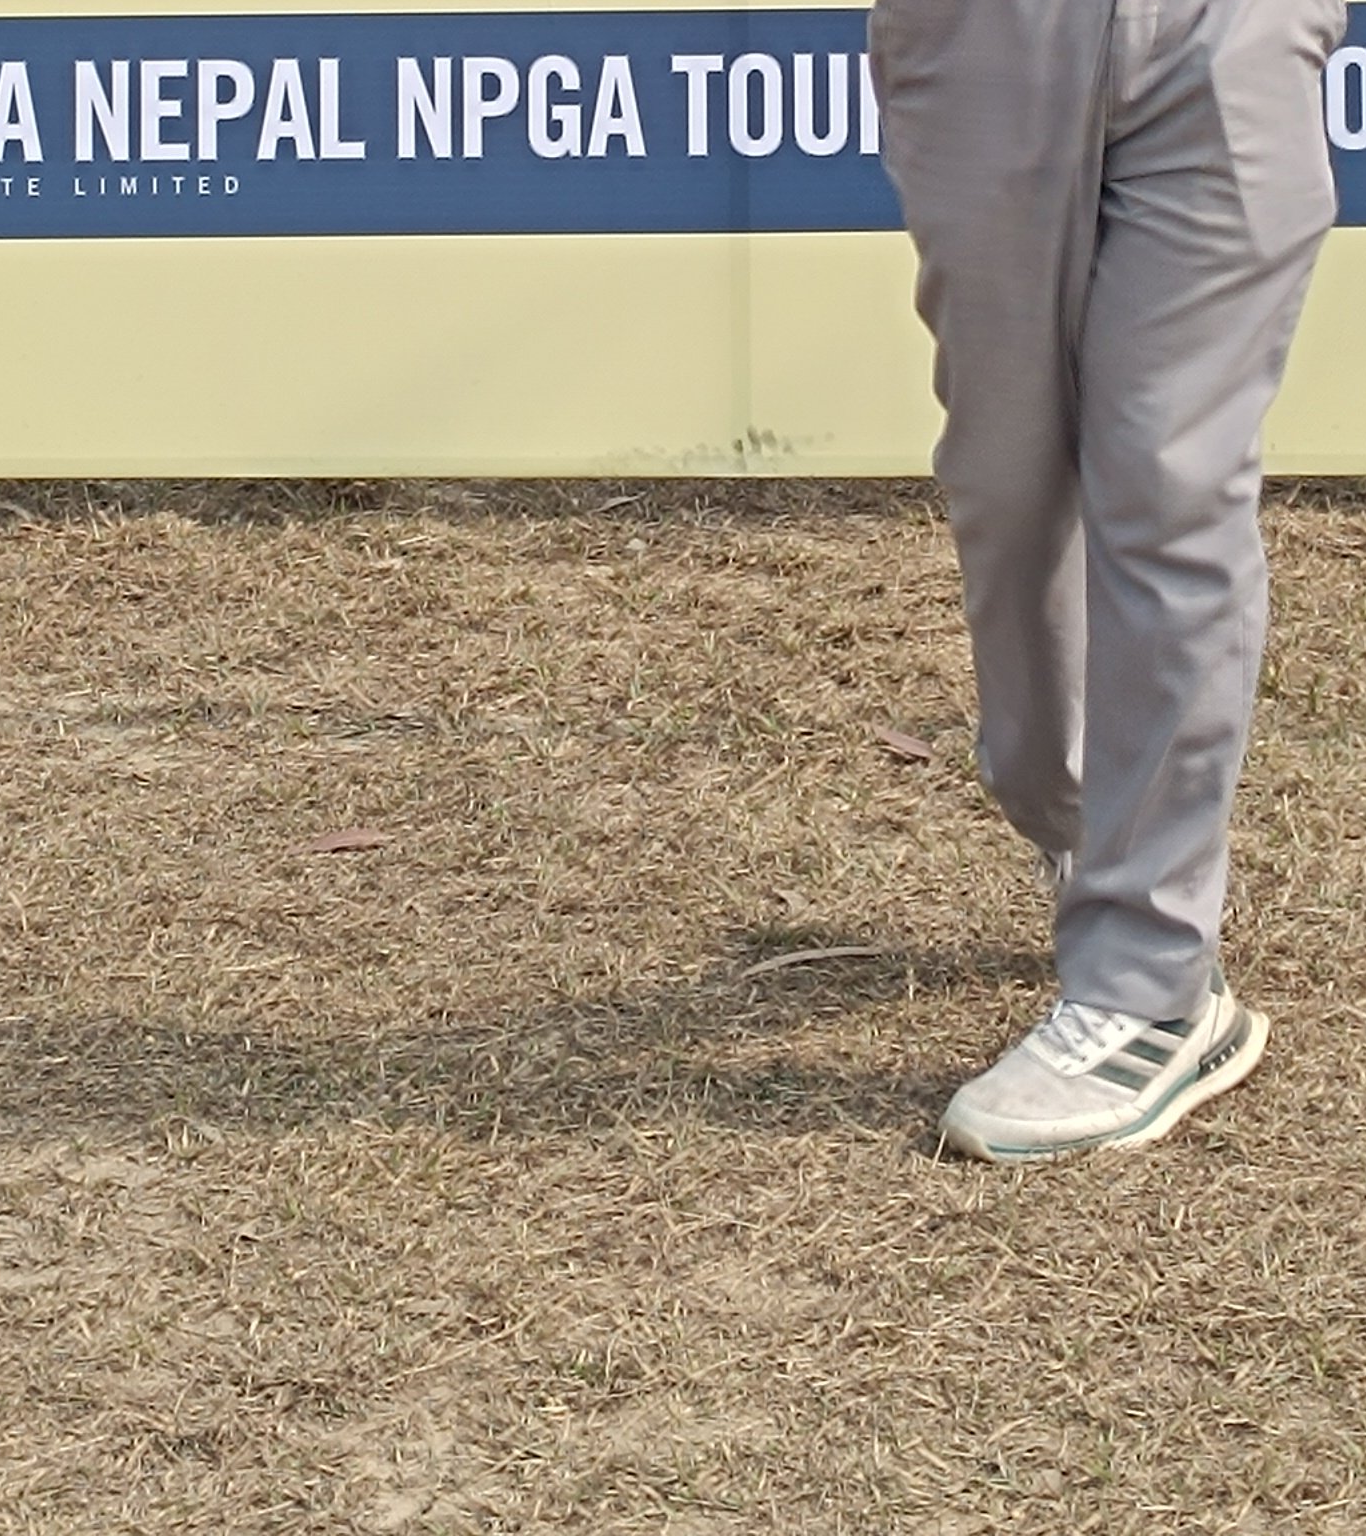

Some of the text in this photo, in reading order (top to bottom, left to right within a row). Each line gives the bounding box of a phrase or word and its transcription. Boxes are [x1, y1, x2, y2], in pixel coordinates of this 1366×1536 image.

[74, 57, 367, 163] NEPAL
[397, 53, 647, 160] NPGA
[74, 175, 242, 197] LIMITED
